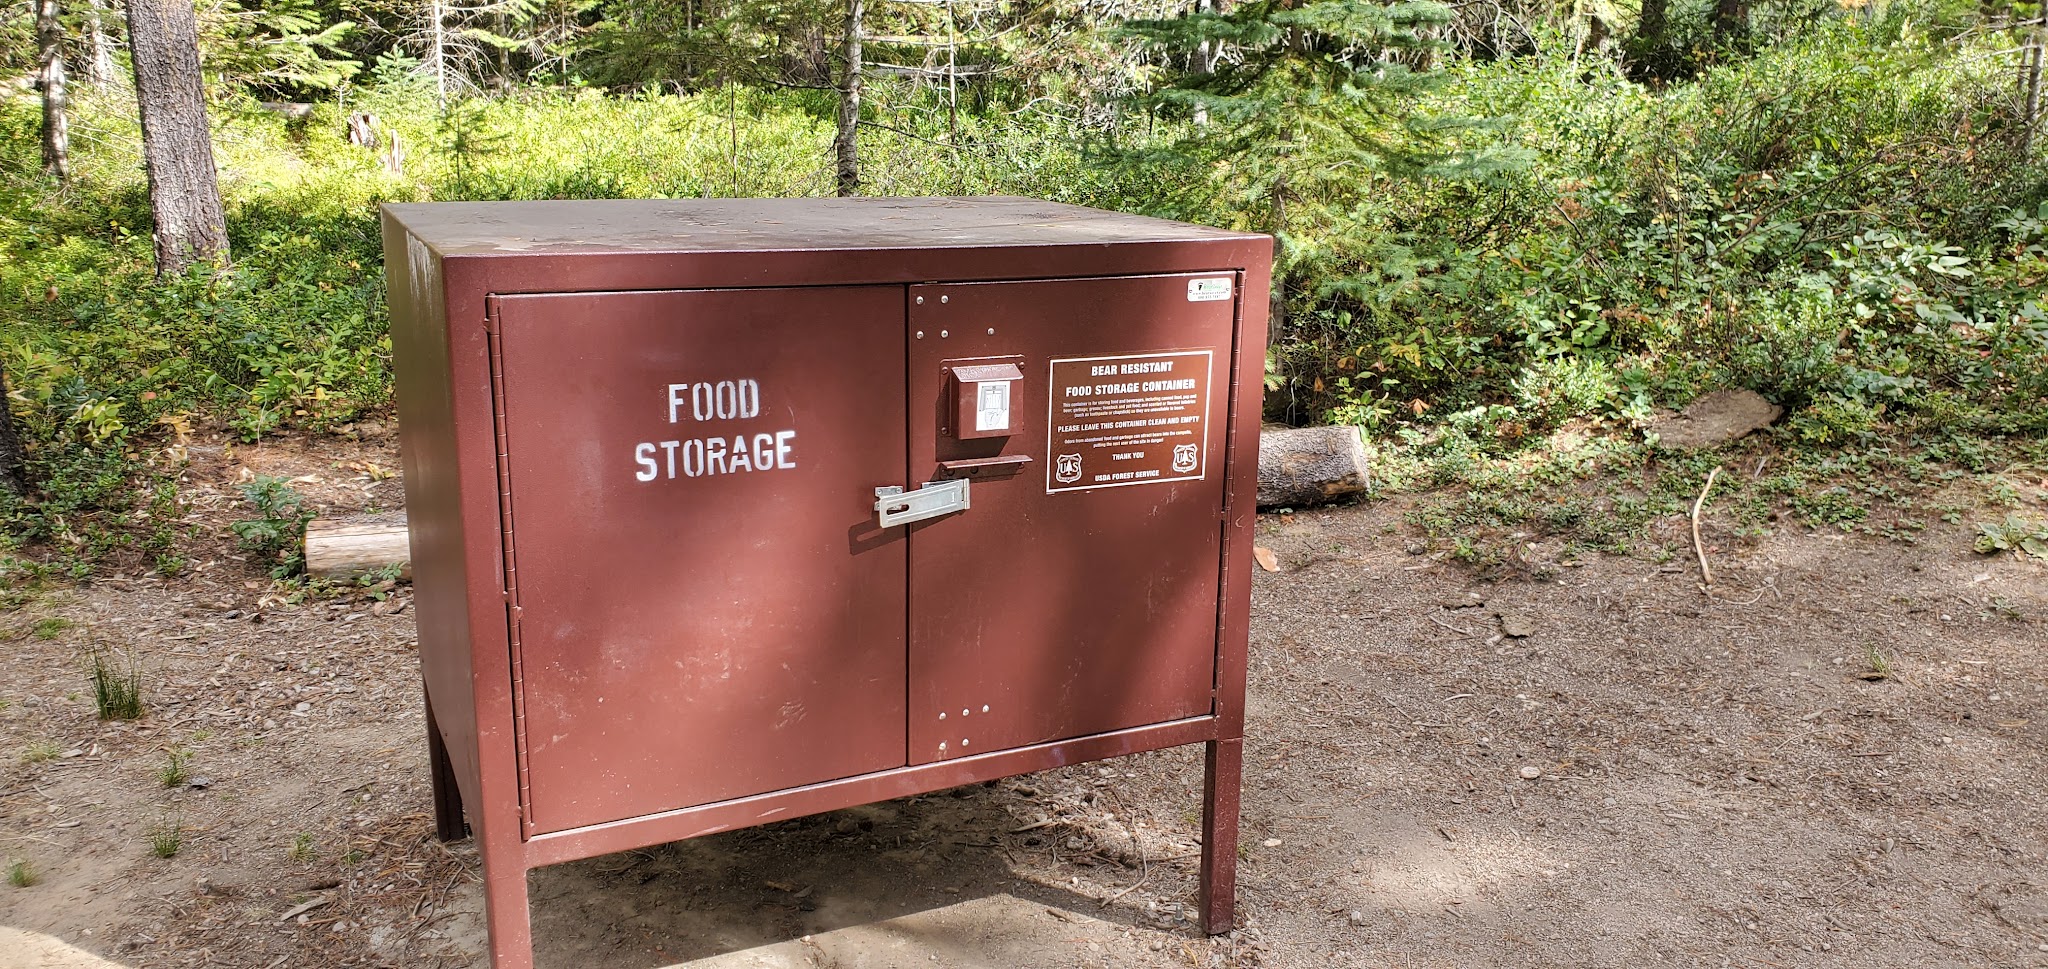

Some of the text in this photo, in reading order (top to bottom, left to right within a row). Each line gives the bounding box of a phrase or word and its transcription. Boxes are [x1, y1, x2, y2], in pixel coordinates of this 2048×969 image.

[1091, 361, 1174, 376] BEAR RESISTANT
[1065, 379, 1196, 397] FOOD STORAGE CONTAINER
[668, 379, 760, 423] FOOD
[1057, 424, 1080, 433] PLEASE
[1081, 423, 1100, 431] LEAVE
[1100, 421, 1114, 429] THIS
[1115, 419, 1147, 428] CONTAINER
[1147, 418, 1167, 426] CLEAN
[1167, 416, 1179, 424] AND
[635, 430, 796, 482] STORAGE
[1112, 453, 1132, 461] THANK
[1112, 472, 1134, 480] FOREST
[1135, 469, 1160, 478] SERVICE
